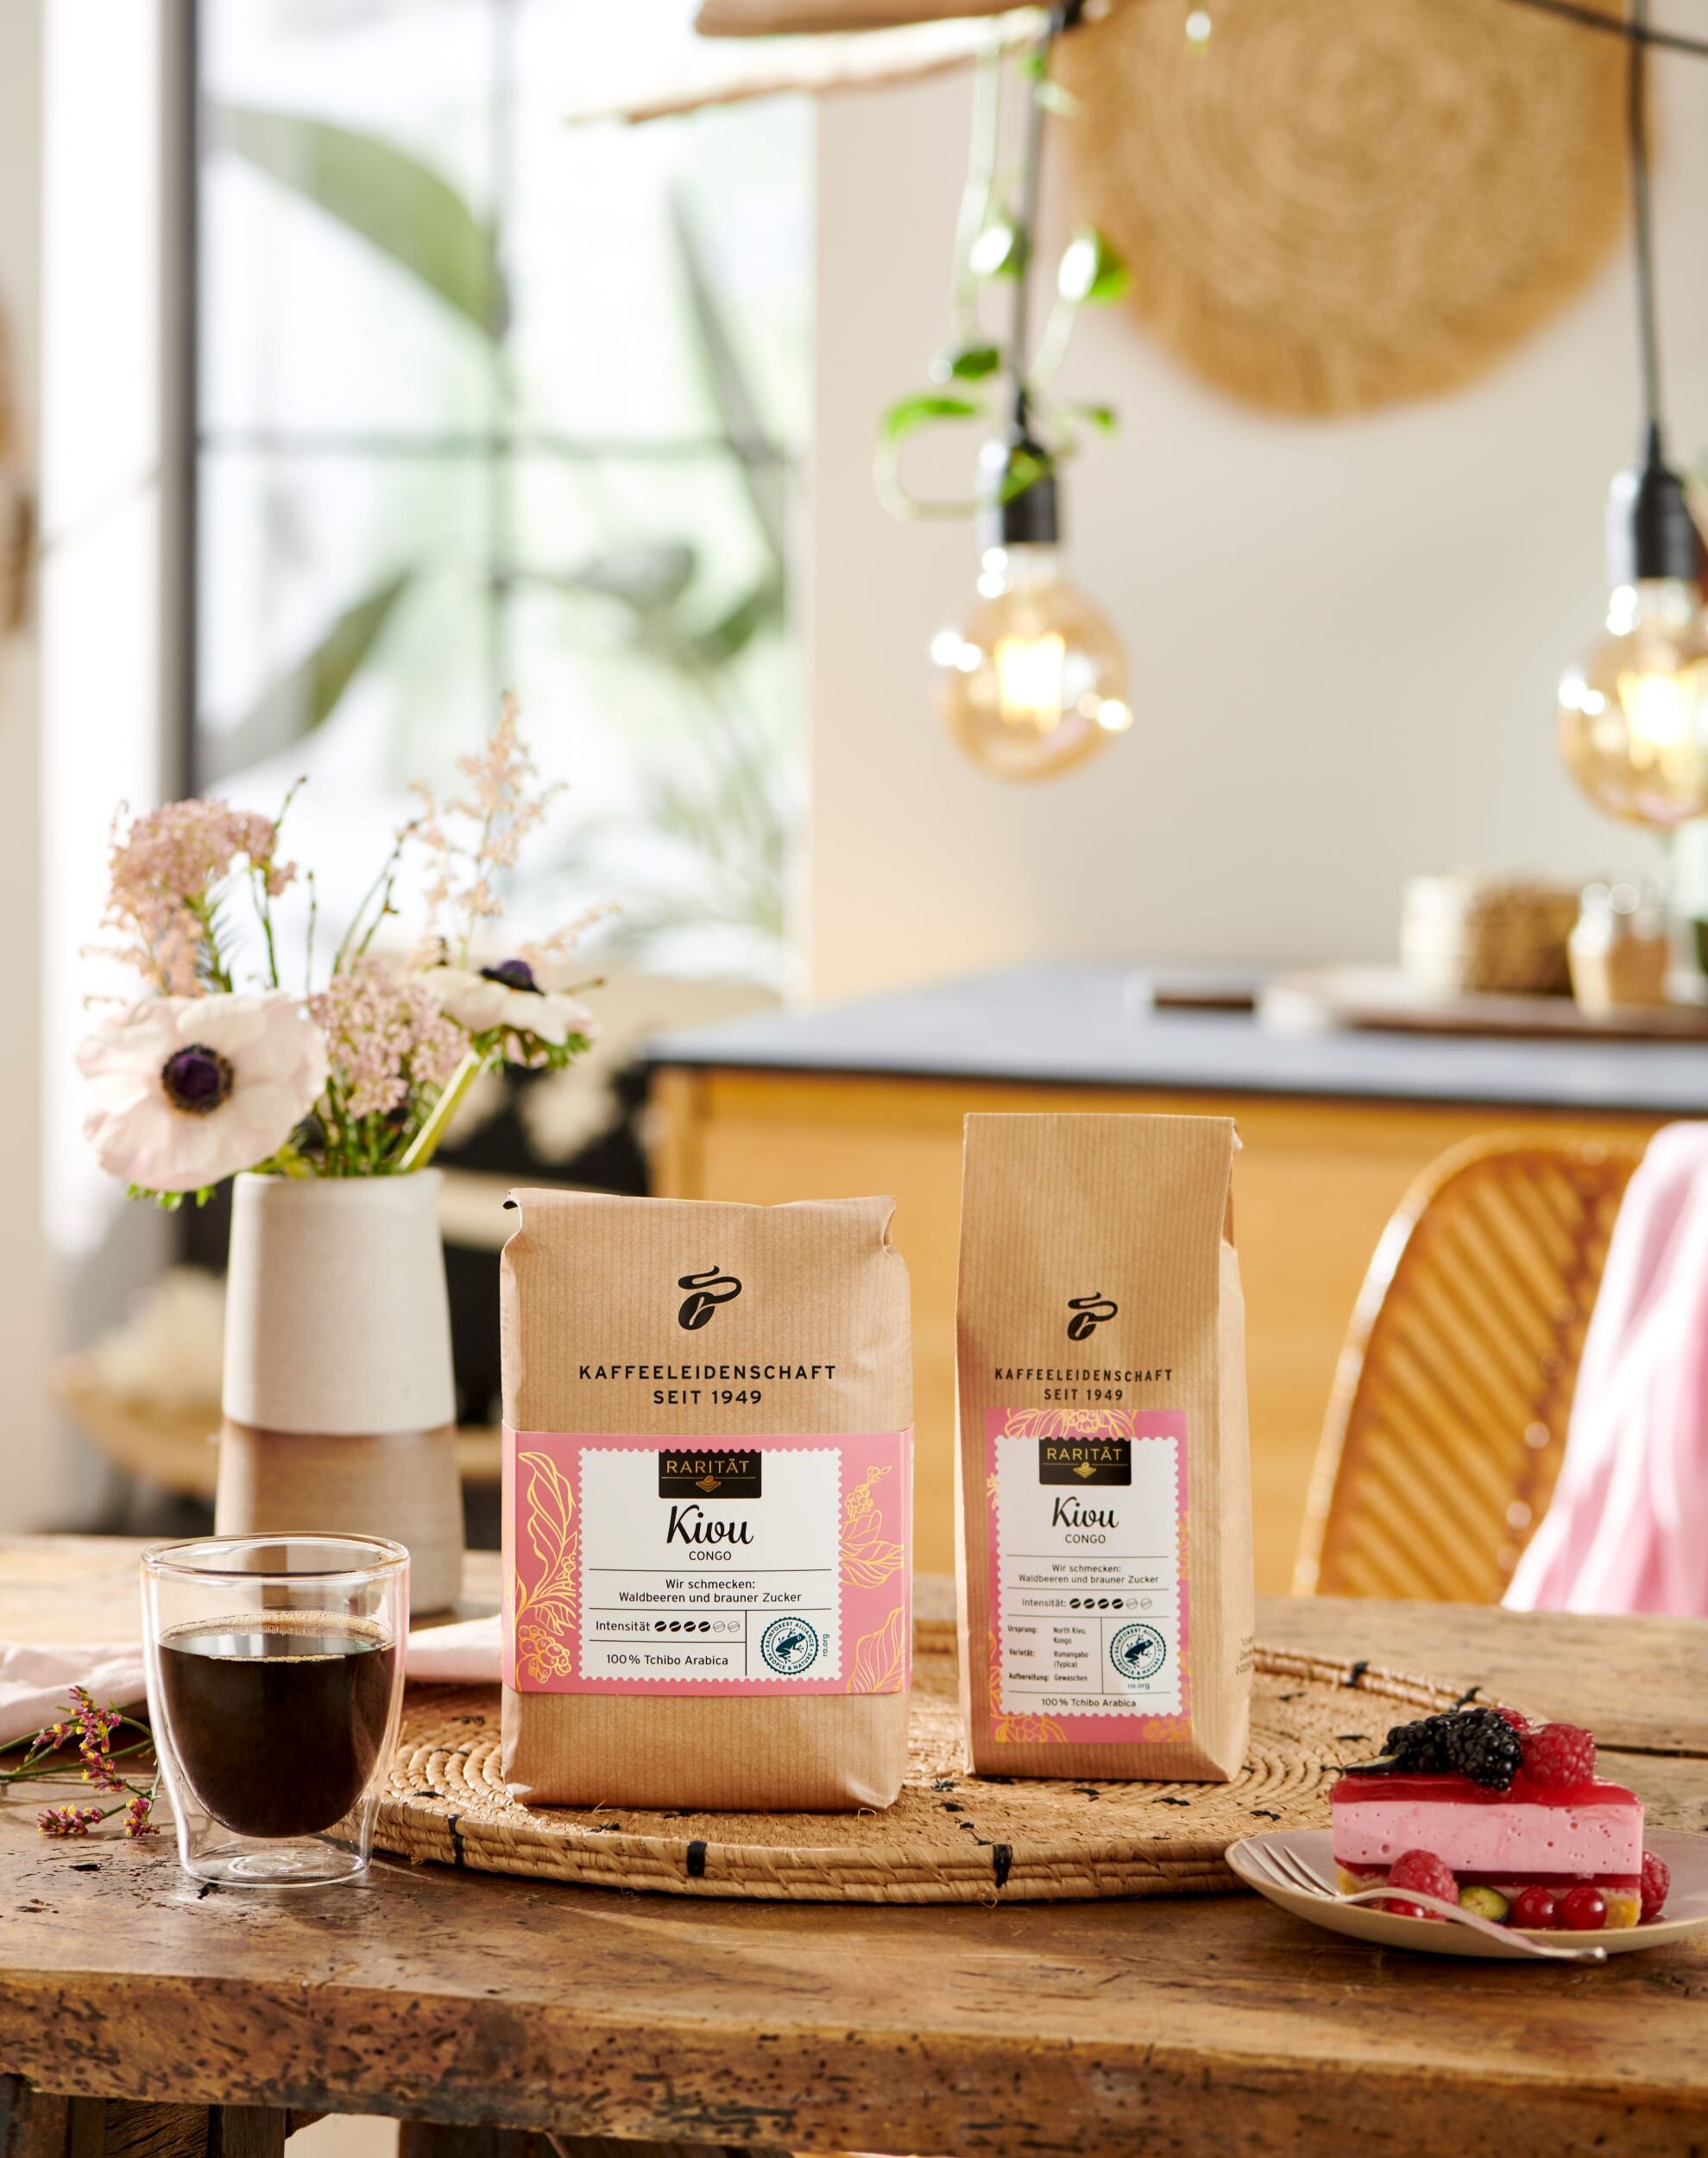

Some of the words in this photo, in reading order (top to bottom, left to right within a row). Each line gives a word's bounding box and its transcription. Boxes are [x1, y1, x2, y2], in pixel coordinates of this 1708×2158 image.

[579, 1365, 836, 1380] KAFFEELEIDENSCHAFT
[994, 1367, 1173, 1382] KAFFEELEIDENSCHAFT
[653, 1390, 702, 1404] SEIT
[712, 1390, 762, 1404] 1949
[1043, 1388, 1079, 1400] SEIT
[1086, 1389, 1123, 1401] 1949
[1046, 1447, 1122, 1461] RARITÄT
[666, 1458, 750, 1473] RARITÄT
[1051, 1495, 1119, 1529] Kivu
[666, 1504, 754, 1545] Kivu
[1064, 1534, 1106, 1544] CONGO
[689, 1550, 732, 1561] CONGO
[1051, 1564, 1066, 1573] Wir
[1068, 1564, 1122, 1573] schmecken:
[665, 1579, 684, 1589] Wir
[688, 1579, 755, 1589] schmecken:
[1018, 1574, 1069, 1583] Waldbeeren
[1071, 1575, 1088, 1584] und
[1090, 1575, 1125, 1584] brauner
[1128, 1575, 1159, 1584] Zucker
[619, 1592, 685, 1602] Waldbeeren
[689, 1593, 710, 1603] und
[714, 1593, 759, 1603] brauner
[762, 1592, 802, 1603] Zucker
[1022, 1598, 1067, 1608] Intensität:
[596, 1620, 651, 1631] Intensität
[1007, 1625, 1038, 1634] Ursprung:
[766, 1621, 792, 1648] RAINFOREST
[795, 1622, 815, 1647] ALLIANCE
[1053, 1637, 1072, 1645] Kongo
[1008, 1648, 1035, 1657] Varietät:
[1053, 1650, 1089, 1659] Rumangabo
[644, 1655, 681, 1665] Tchibo
[684, 1655, 728, 1665] Arabica
[767, 1653, 785, 1670] PEOPLE
[793, 1652, 812, 1670] NATURE
[1053, 1660, 1078, 1669] (Typica)
[1008, 1673, 1049, 1682] Aufbereitung:
[1071, 1698, 1100, 1707] Tchibo
[1102, 1698, 1137, 1707] Arabica
